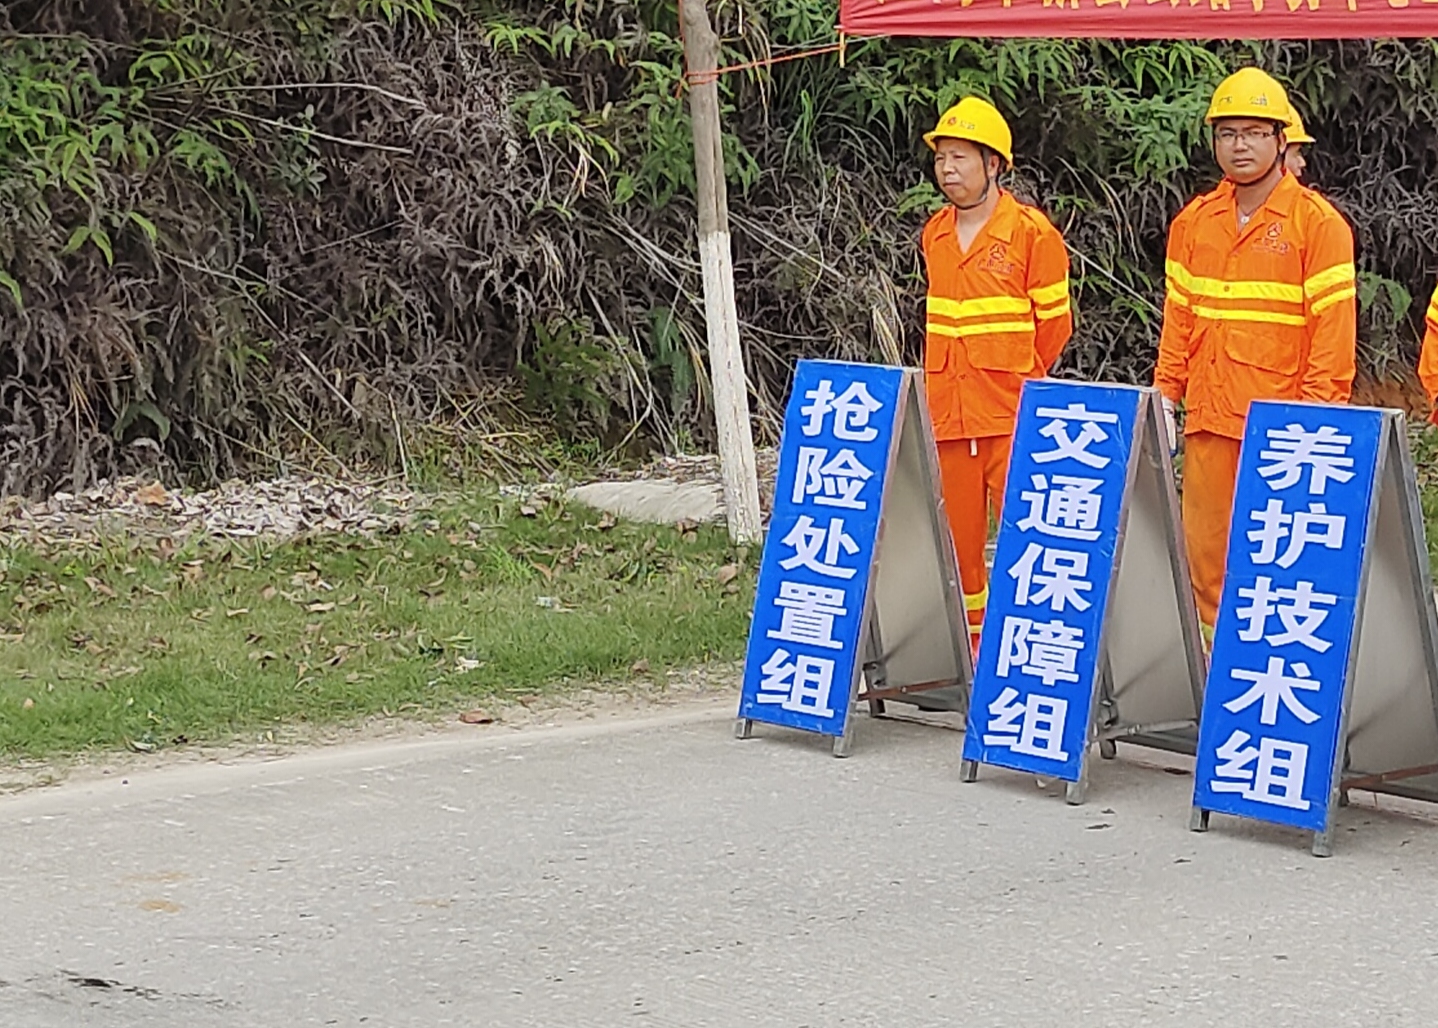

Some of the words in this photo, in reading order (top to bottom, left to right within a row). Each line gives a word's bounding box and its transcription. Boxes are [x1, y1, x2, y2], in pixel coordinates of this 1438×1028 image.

[757, 380, 883, 718] 抢险处置组
[984, 403, 1119, 763] 交通保障组
[1210, 423, 1356, 811] 养护技术组
